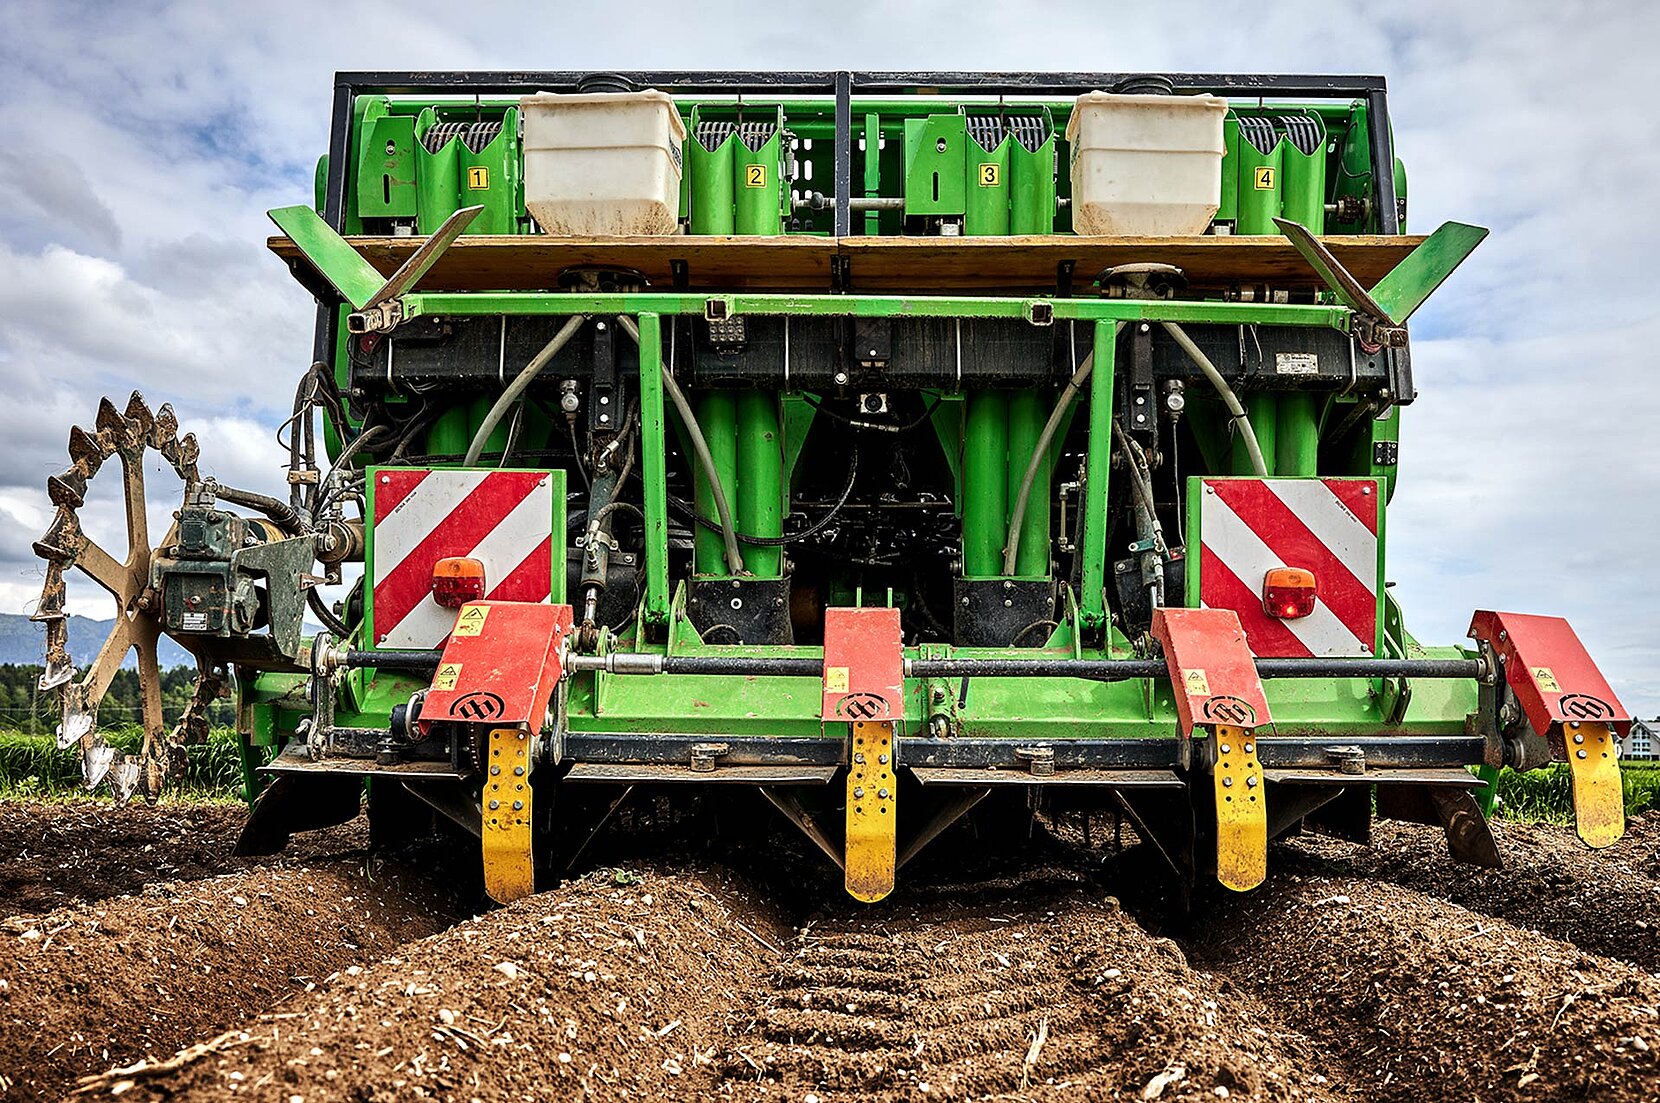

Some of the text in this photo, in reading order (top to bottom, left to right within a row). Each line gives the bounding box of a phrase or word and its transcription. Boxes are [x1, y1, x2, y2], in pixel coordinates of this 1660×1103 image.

[473, 170, 481, 186] 1
[751, 167, 762, 184] 2
[984, 166, 995, 183] 3
[1260, 170, 1271, 186] 4
